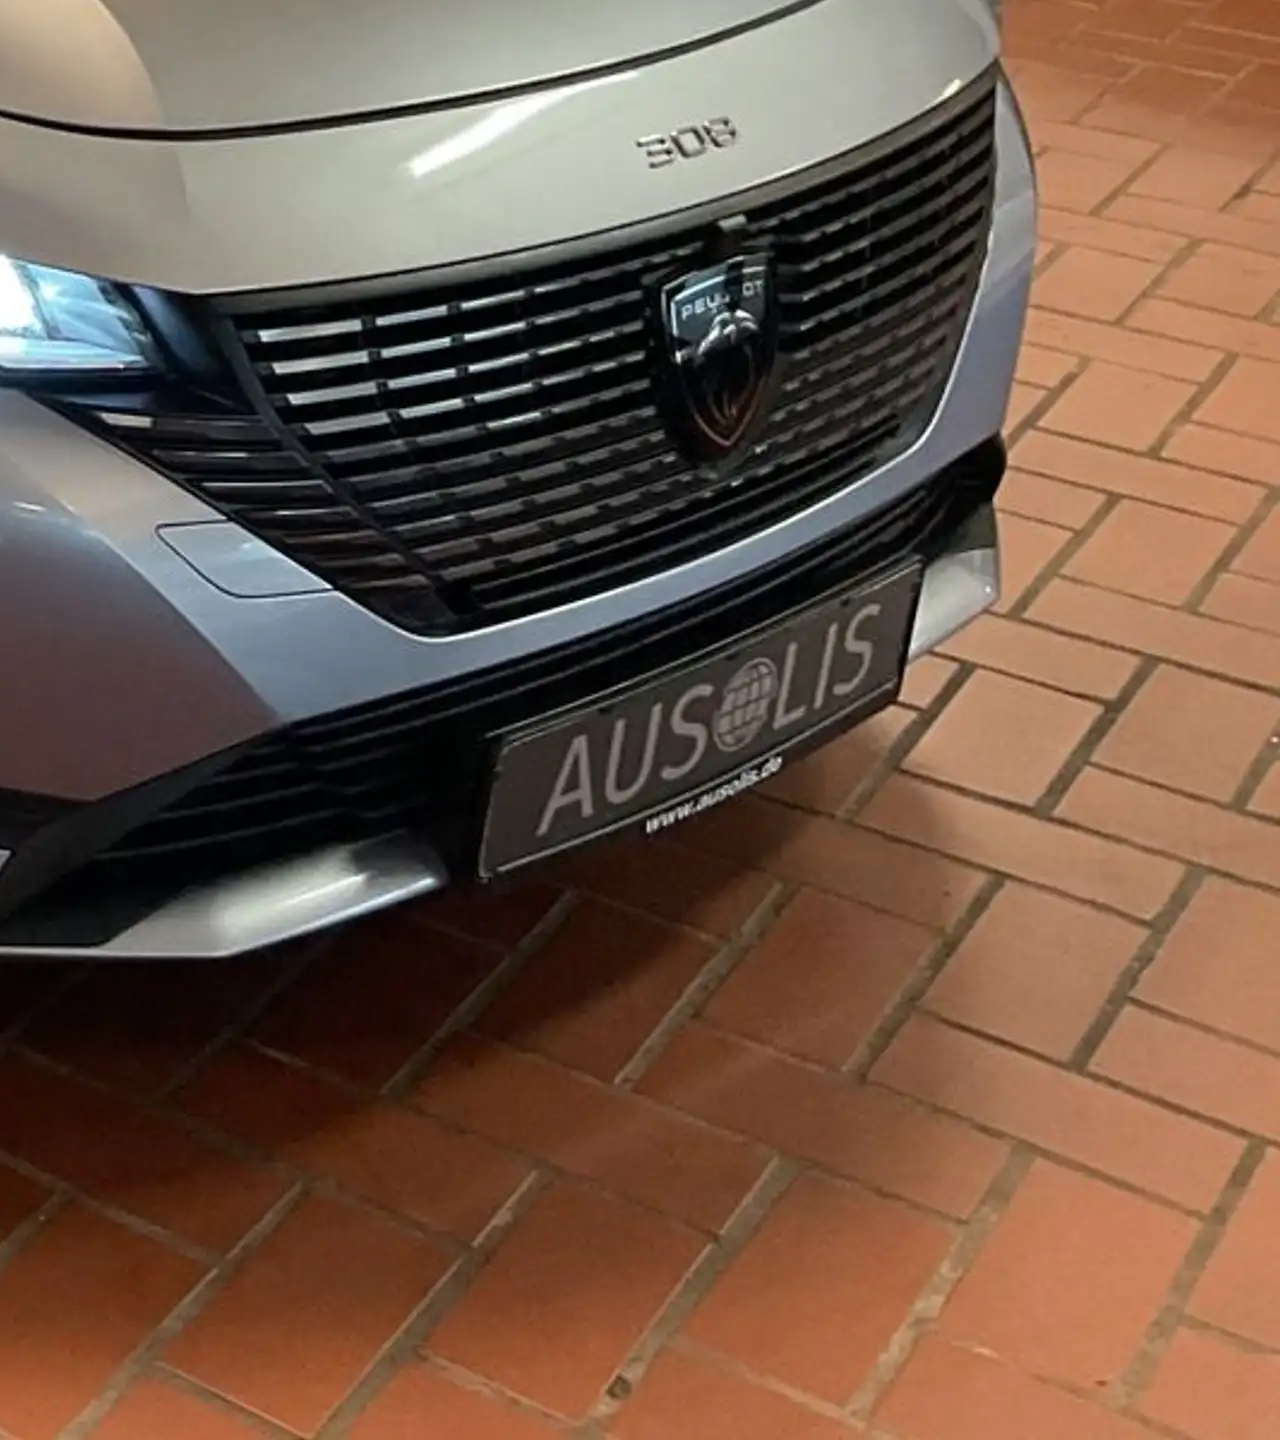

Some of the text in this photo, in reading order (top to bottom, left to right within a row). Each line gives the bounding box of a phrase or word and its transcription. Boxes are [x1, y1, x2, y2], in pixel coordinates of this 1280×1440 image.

[635, 116, 737, 169] 308
[534, 602, 882, 837] AUSOLIS
[645, 755, 783, 835] www.ausolis.de
